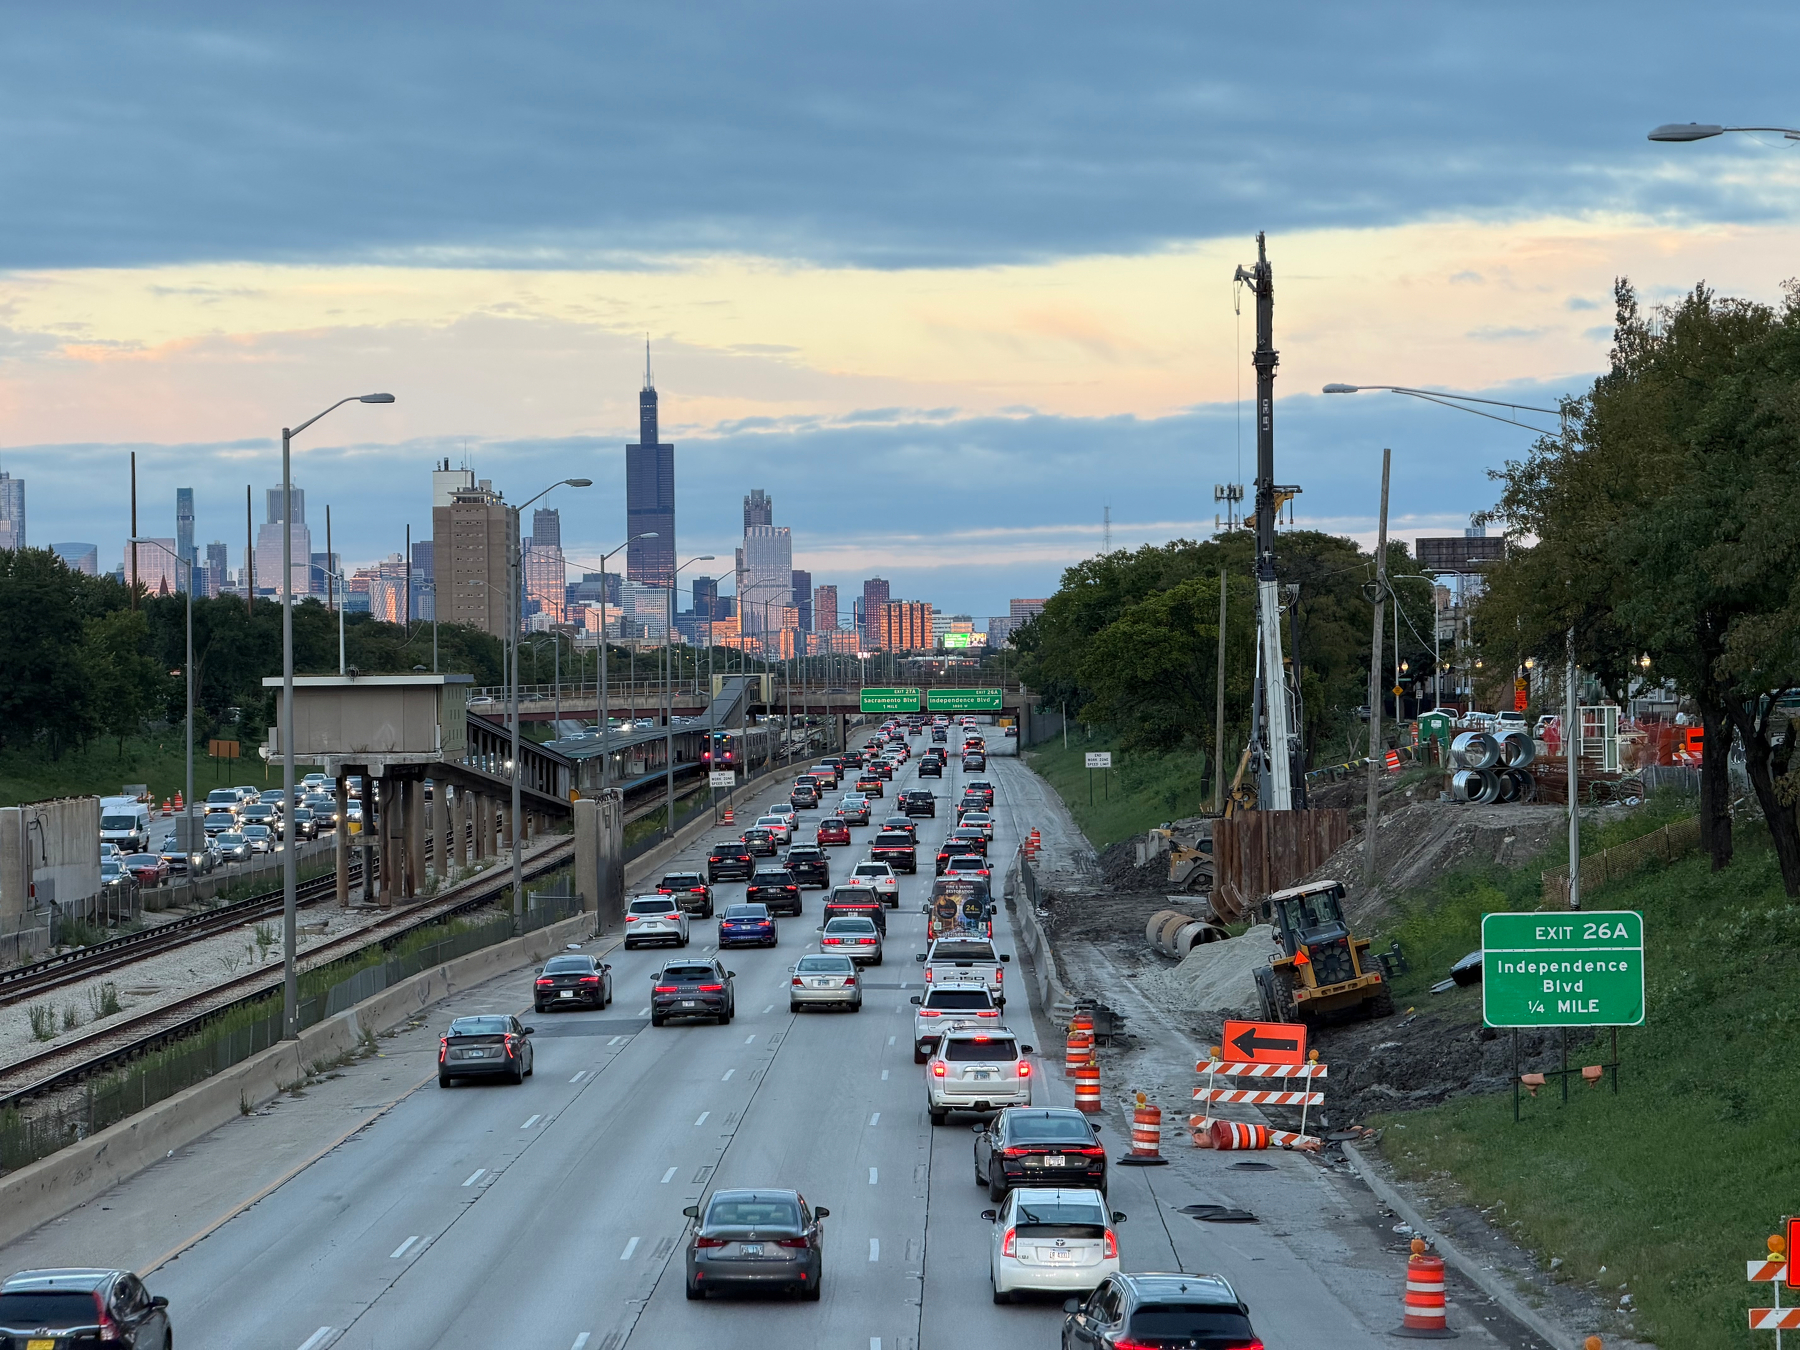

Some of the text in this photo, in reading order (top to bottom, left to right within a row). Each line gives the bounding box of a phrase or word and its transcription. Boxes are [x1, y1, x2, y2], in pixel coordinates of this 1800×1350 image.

[1535, 922, 1629, 940] EXIT 26A
[1498, 960, 1629, 976] Independence
[1543, 979, 1584, 993] Blvd
[1557, 999, 1600, 1013] MILE
